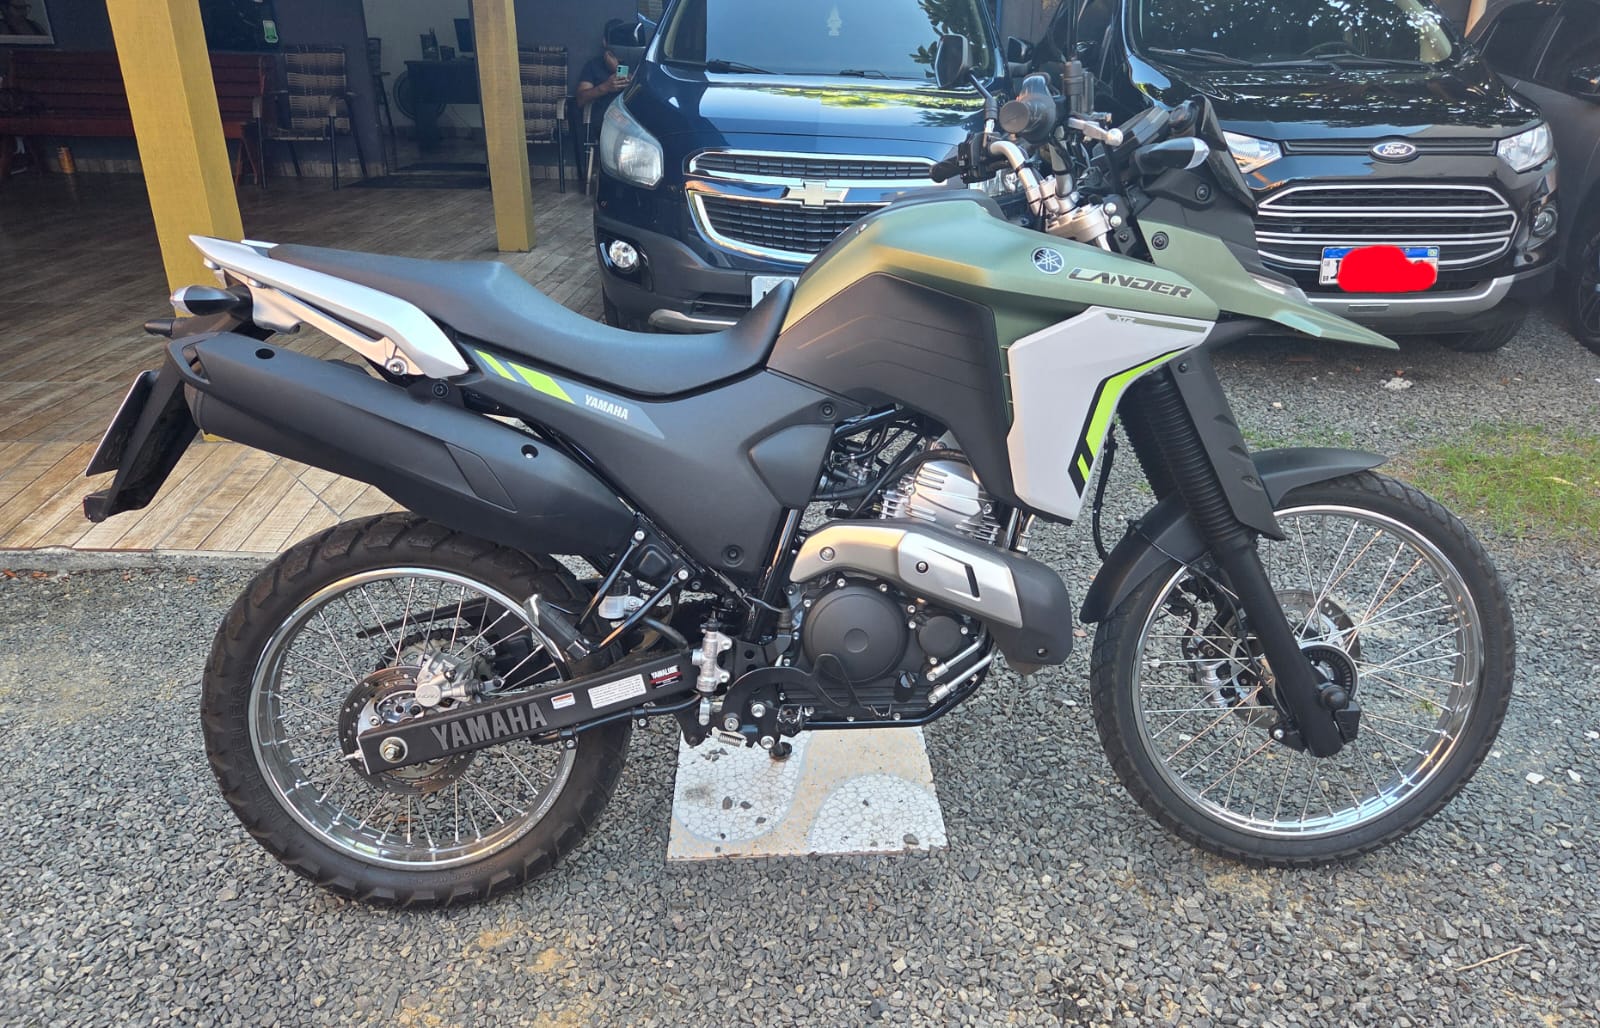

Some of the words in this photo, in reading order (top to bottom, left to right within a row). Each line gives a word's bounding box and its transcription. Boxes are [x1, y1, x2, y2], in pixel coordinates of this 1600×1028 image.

[1382, 144, 1407, 155] Ford
[1069, 268, 1193, 299] LANDER
[585, 394, 629, 421] YAMAHA
[430, 702, 548, 751] YAMAHA
